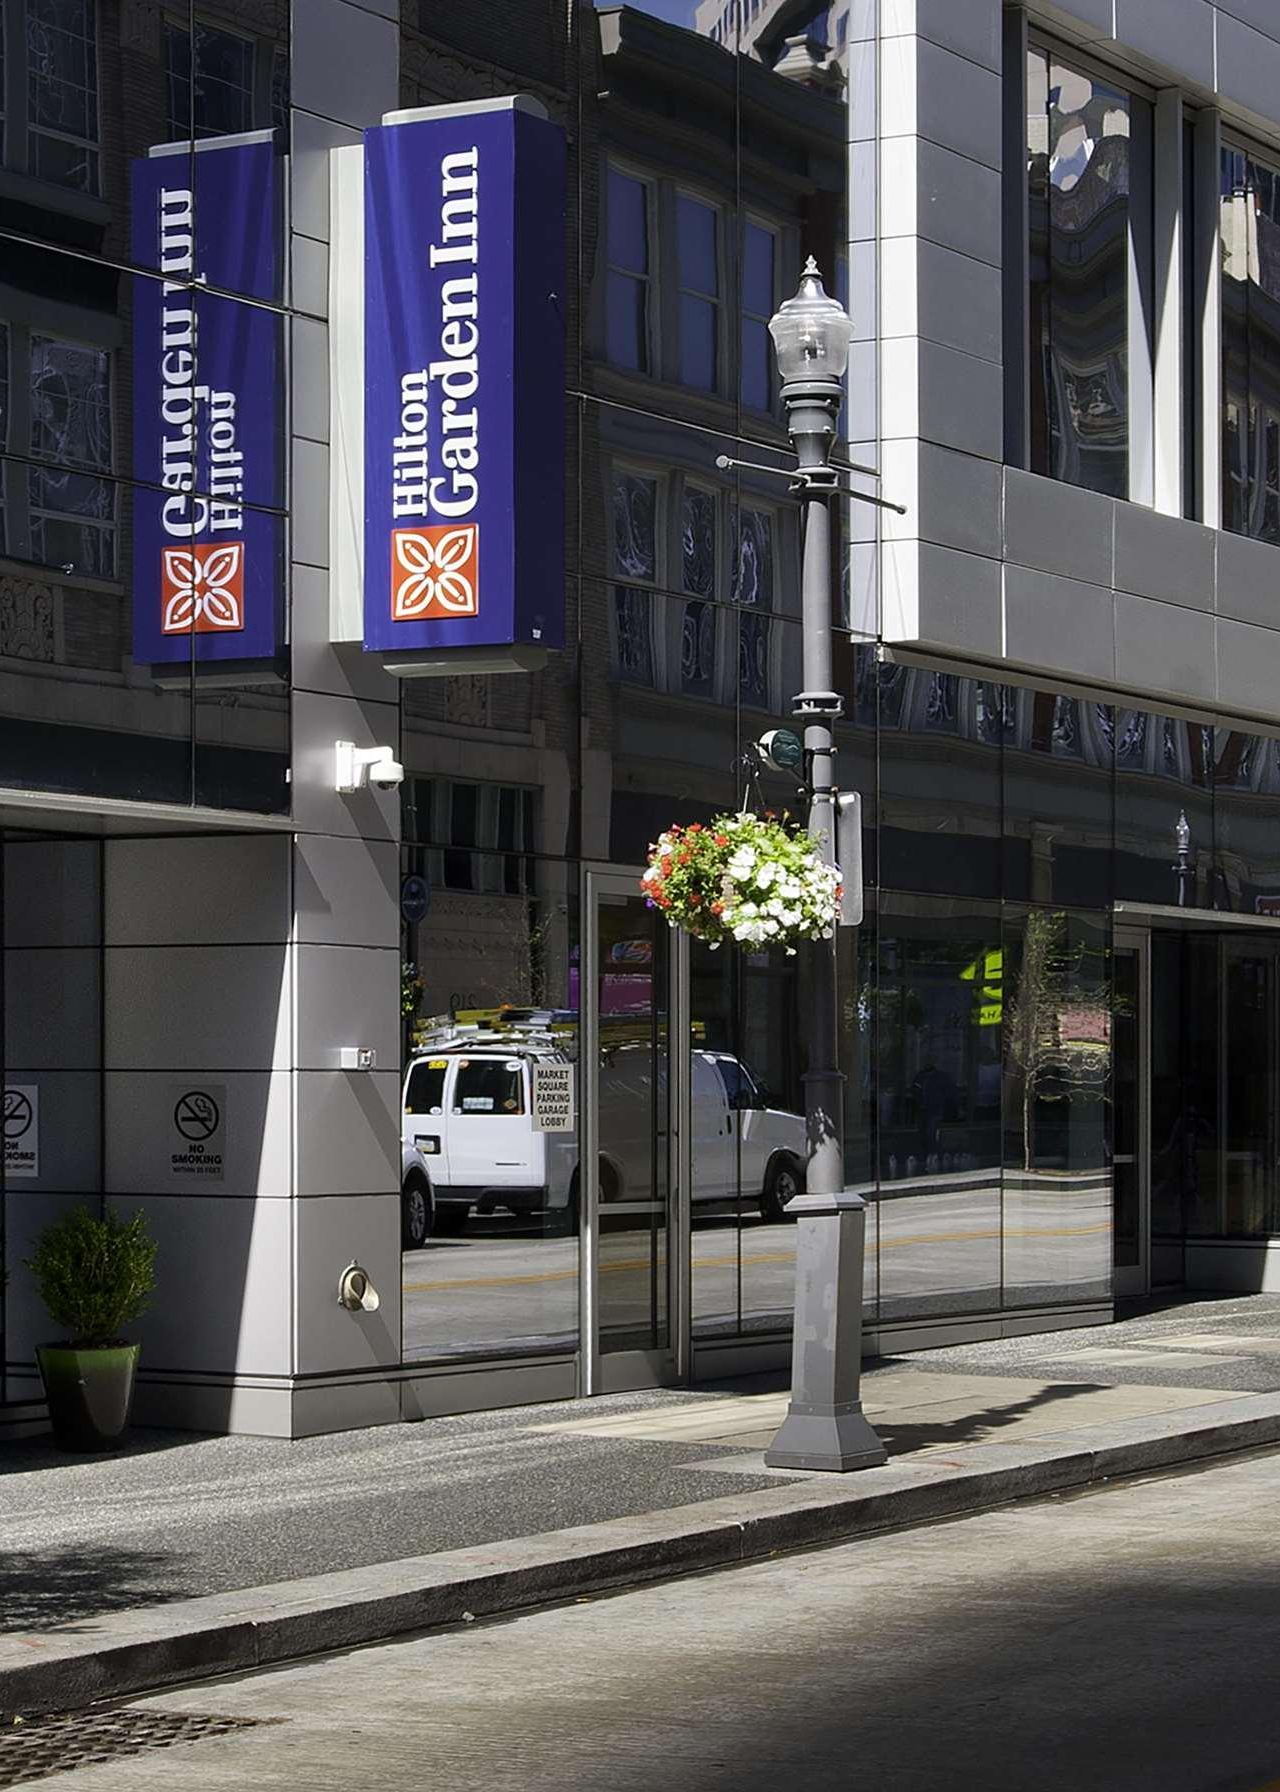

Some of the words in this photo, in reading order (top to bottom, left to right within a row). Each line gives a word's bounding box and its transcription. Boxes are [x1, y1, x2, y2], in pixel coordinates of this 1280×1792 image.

[429, 146, 479, 269] Inn
[429, 272, 479, 517] Garden
[393, 369, 428, 519] Hilton
[537, 1070, 569, 1079] MARKET
[537, 1082, 569, 1092] SQUARE
[536, 1094, 570, 1103] PARKING
[537, 1105, 569, 1115] GARAGE
[540, 1117, 566, 1126] LOBBY
[188, 1144, 205, 1153] NO
[171, 1154, 222, 1164] SMOKING
